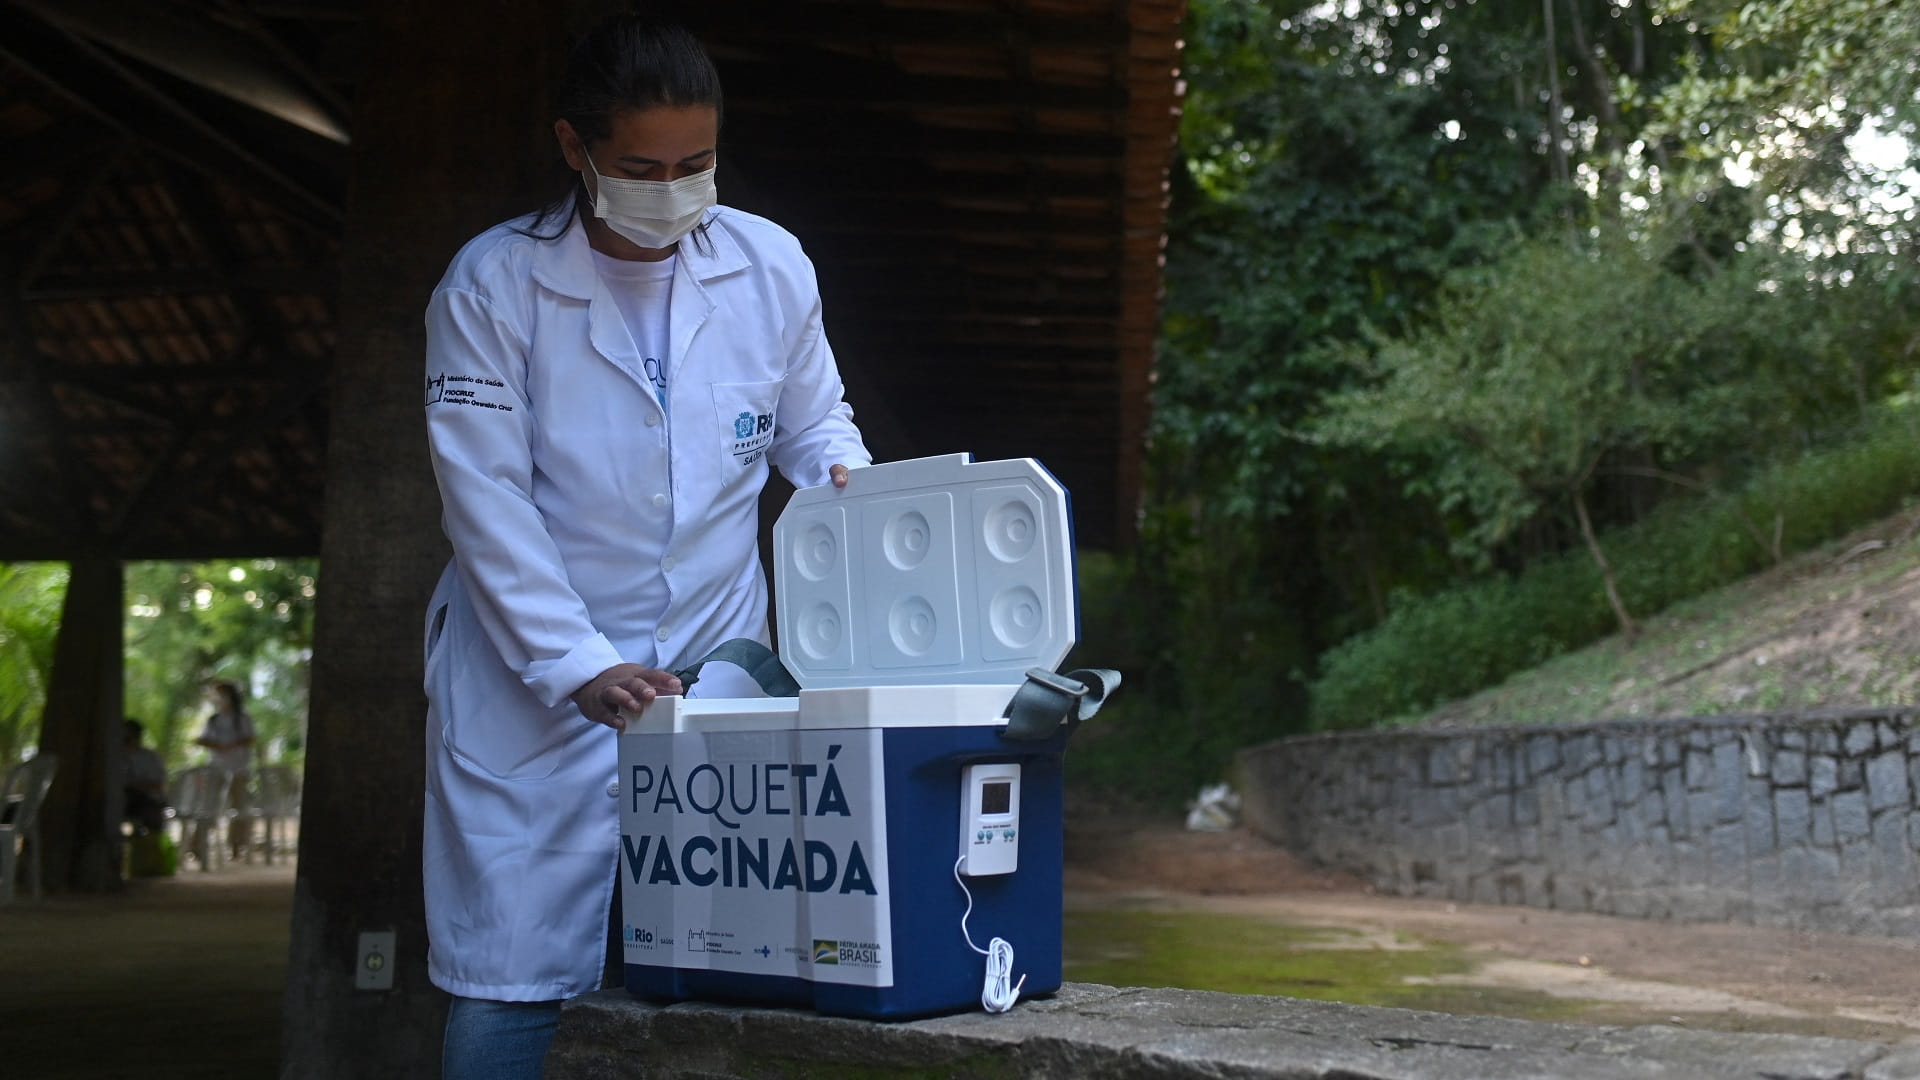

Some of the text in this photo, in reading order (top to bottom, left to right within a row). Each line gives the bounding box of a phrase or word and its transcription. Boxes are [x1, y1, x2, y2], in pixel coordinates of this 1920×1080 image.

[447, 375, 473, 383] Ministério
[484, 379, 504, 387] Saúde
[444, 390, 475, 398] FIOCRUZ
[498, 404, 513, 412] Cruz
[632, 744, 851, 829] PAQUETÁ
[621, 834, 878, 895] VACINADA
[634, 927, 653, 943] Rio
[840, 949, 881, 964] BRASIL
